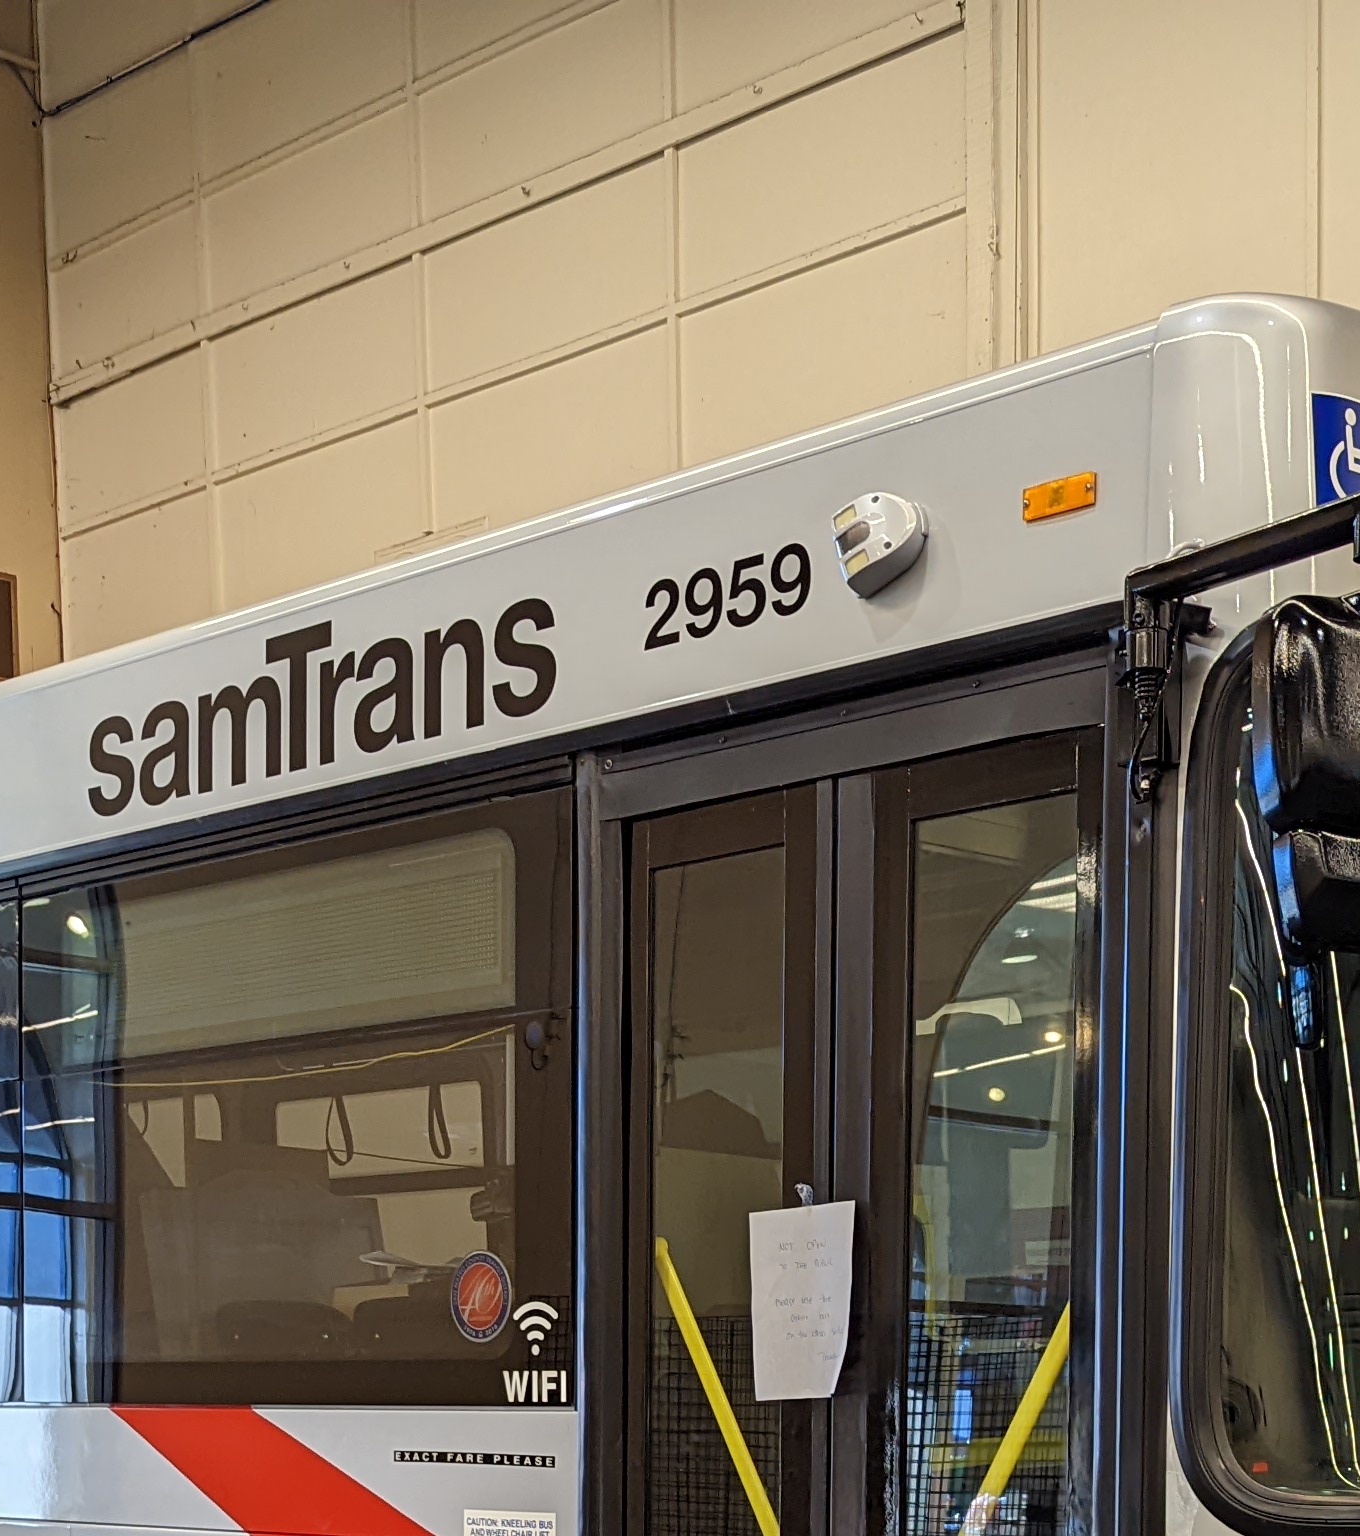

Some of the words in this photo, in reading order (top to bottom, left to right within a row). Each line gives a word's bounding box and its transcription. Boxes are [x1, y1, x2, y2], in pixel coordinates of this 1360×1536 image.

[643, 542, 813, 652] 2959
[87, 598, 557, 818] samTrans
[779, 1242, 795, 1251] NOT
[502, 1370, 567, 1403] WIFI
[395, 1452, 438, 1461] EXACT
[447, 1453, 484, 1463] FARE
[493, 1455, 554, 1467] PLEASE
[466, 1517, 498, 1527] CAUTION:
[501, 1518, 537, 1529] KNEELING
[539, 1520, 554, 1530] BUS
[470, 1529, 485, 1536] AND
